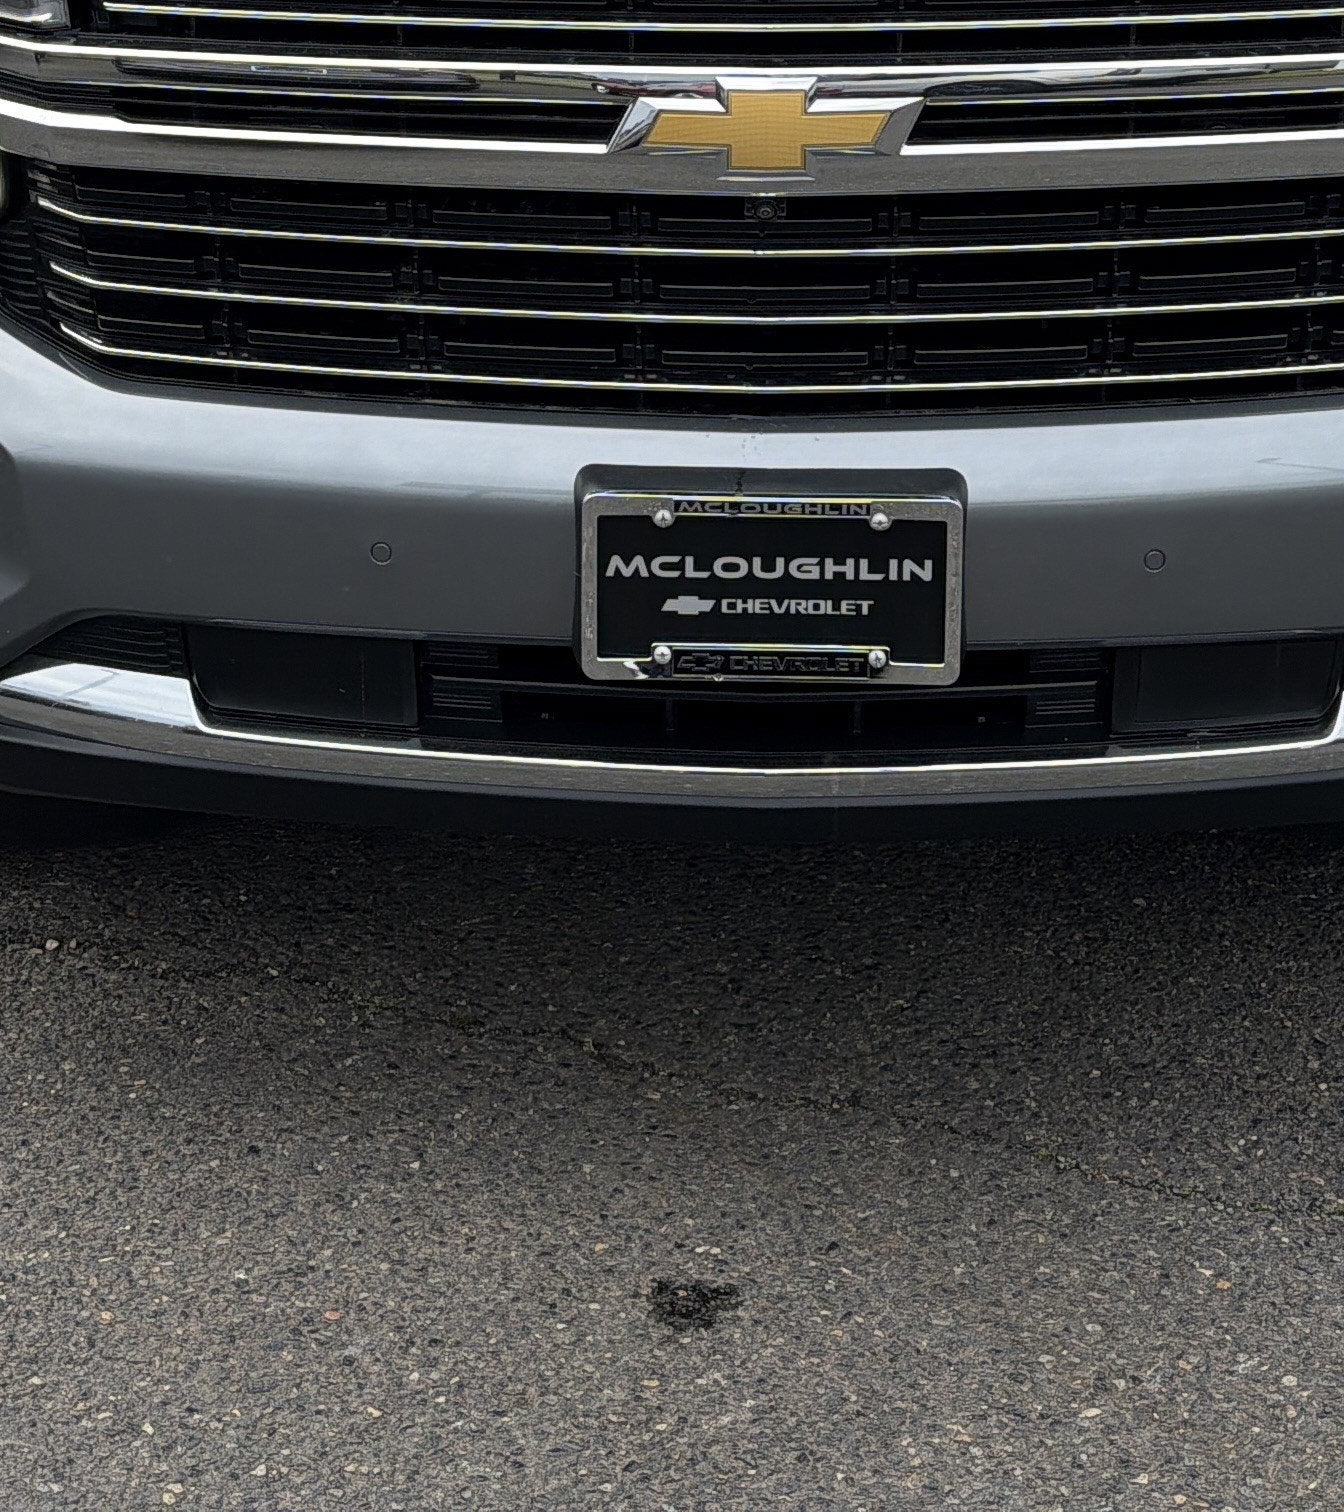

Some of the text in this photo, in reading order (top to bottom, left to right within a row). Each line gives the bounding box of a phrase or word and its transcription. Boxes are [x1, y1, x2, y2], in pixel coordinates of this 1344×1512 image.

[678, 501, 869, 516] MCLOUGHLIN
[606, 554, 933, 582] MCLOUGHLIN
[721, 598, 874, 616] CHEVROLET
[729, 655, 865, 672] CHEVROLET
